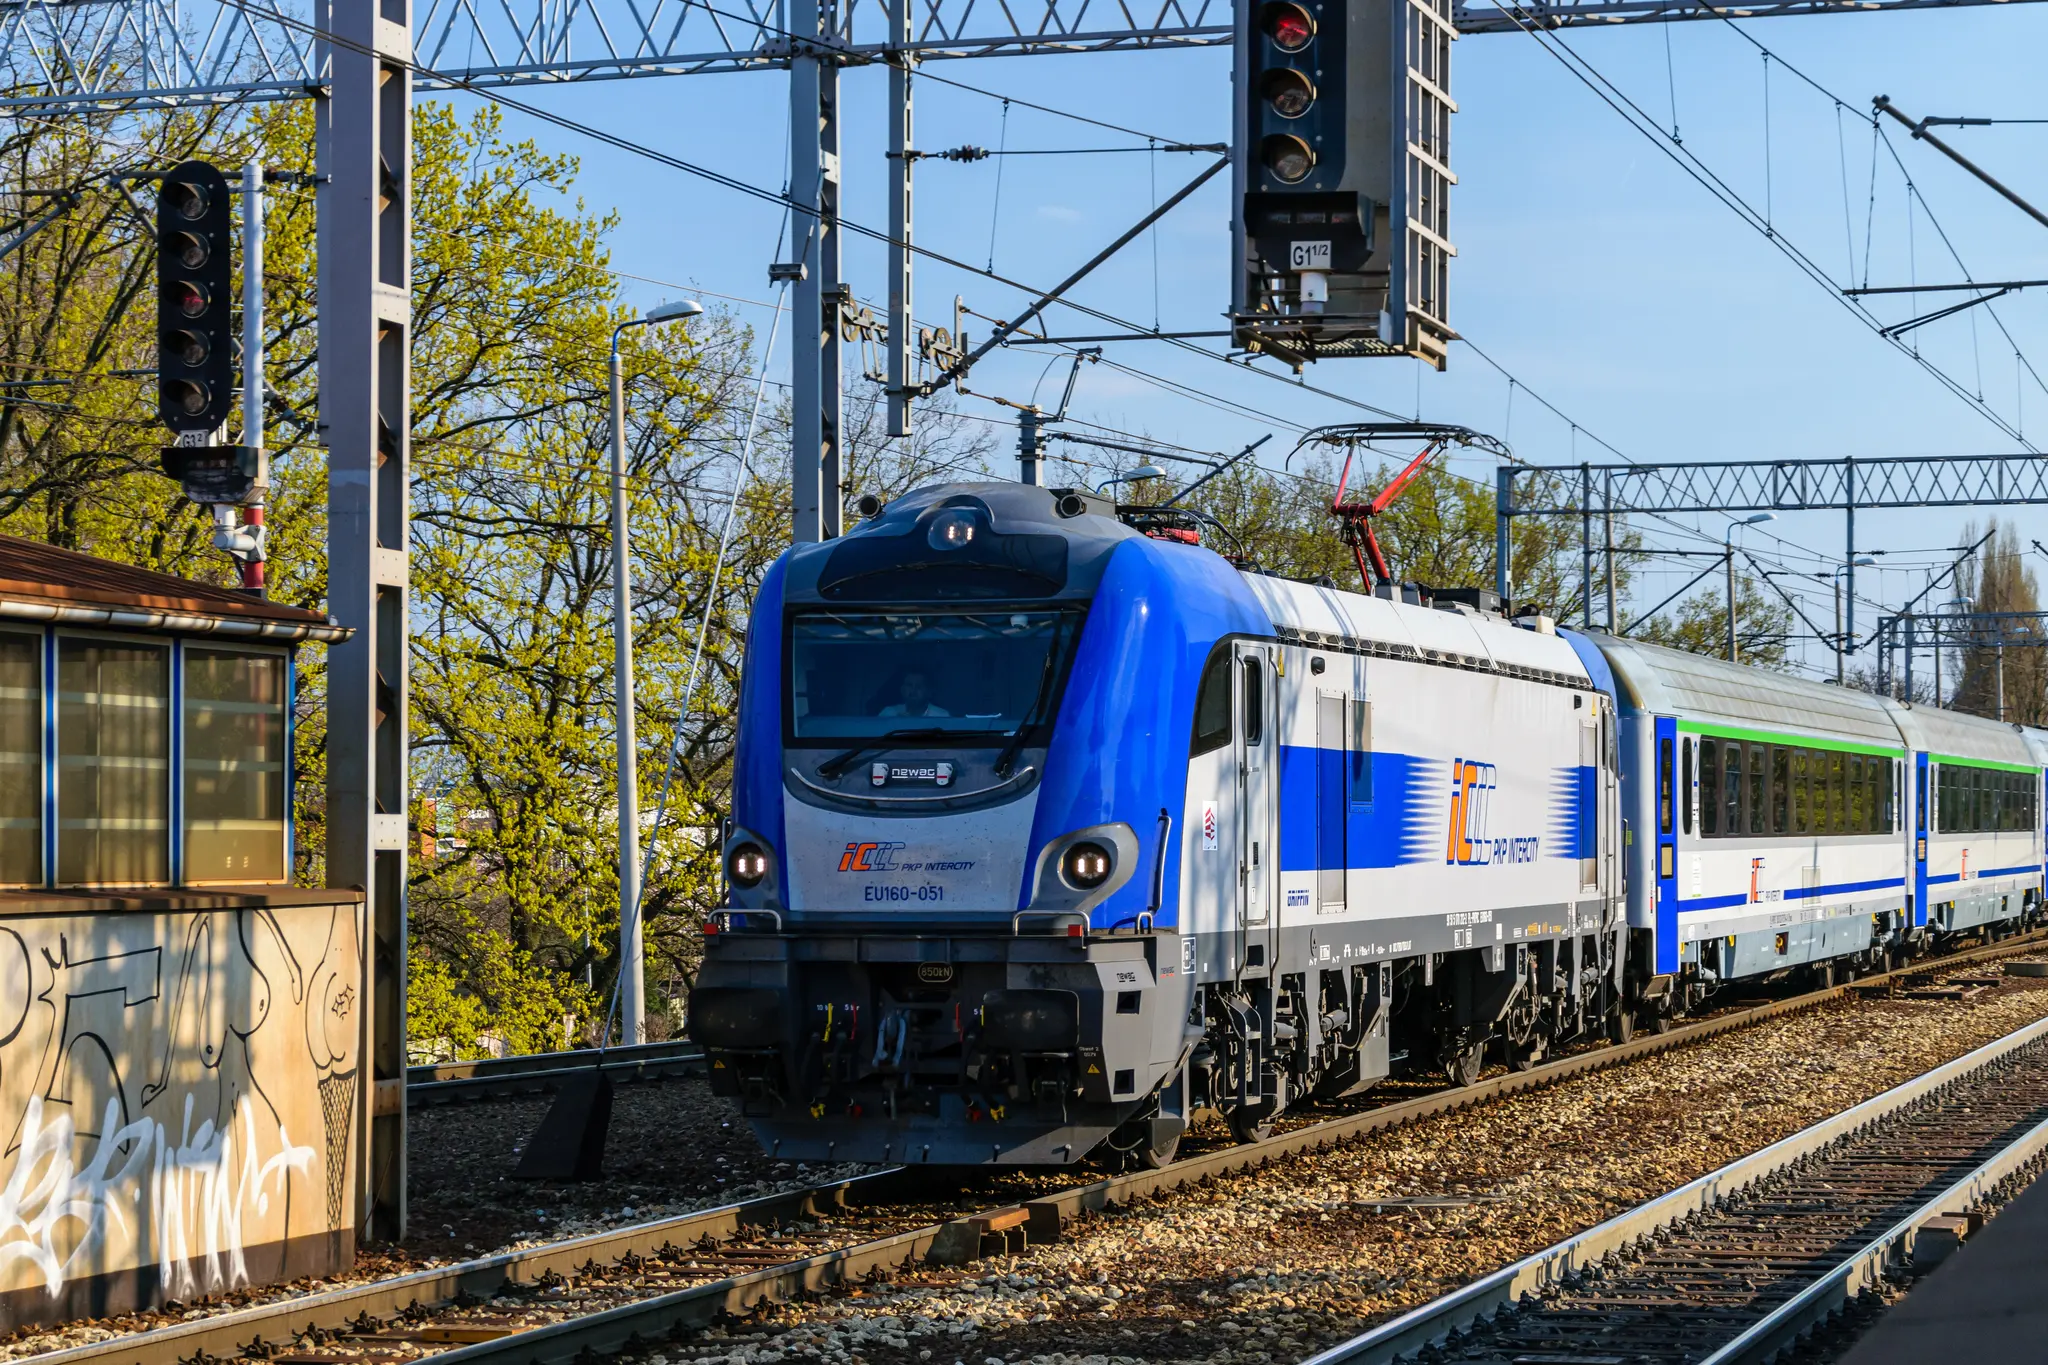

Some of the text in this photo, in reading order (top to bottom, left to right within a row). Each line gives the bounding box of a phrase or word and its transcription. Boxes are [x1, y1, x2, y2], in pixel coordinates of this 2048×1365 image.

[1493, 836, 1540, 865] PKP INTERCITY
[901, 861, 976, 872] PKP INTERCITY
[864, 886, 943, 901] EU160-051
